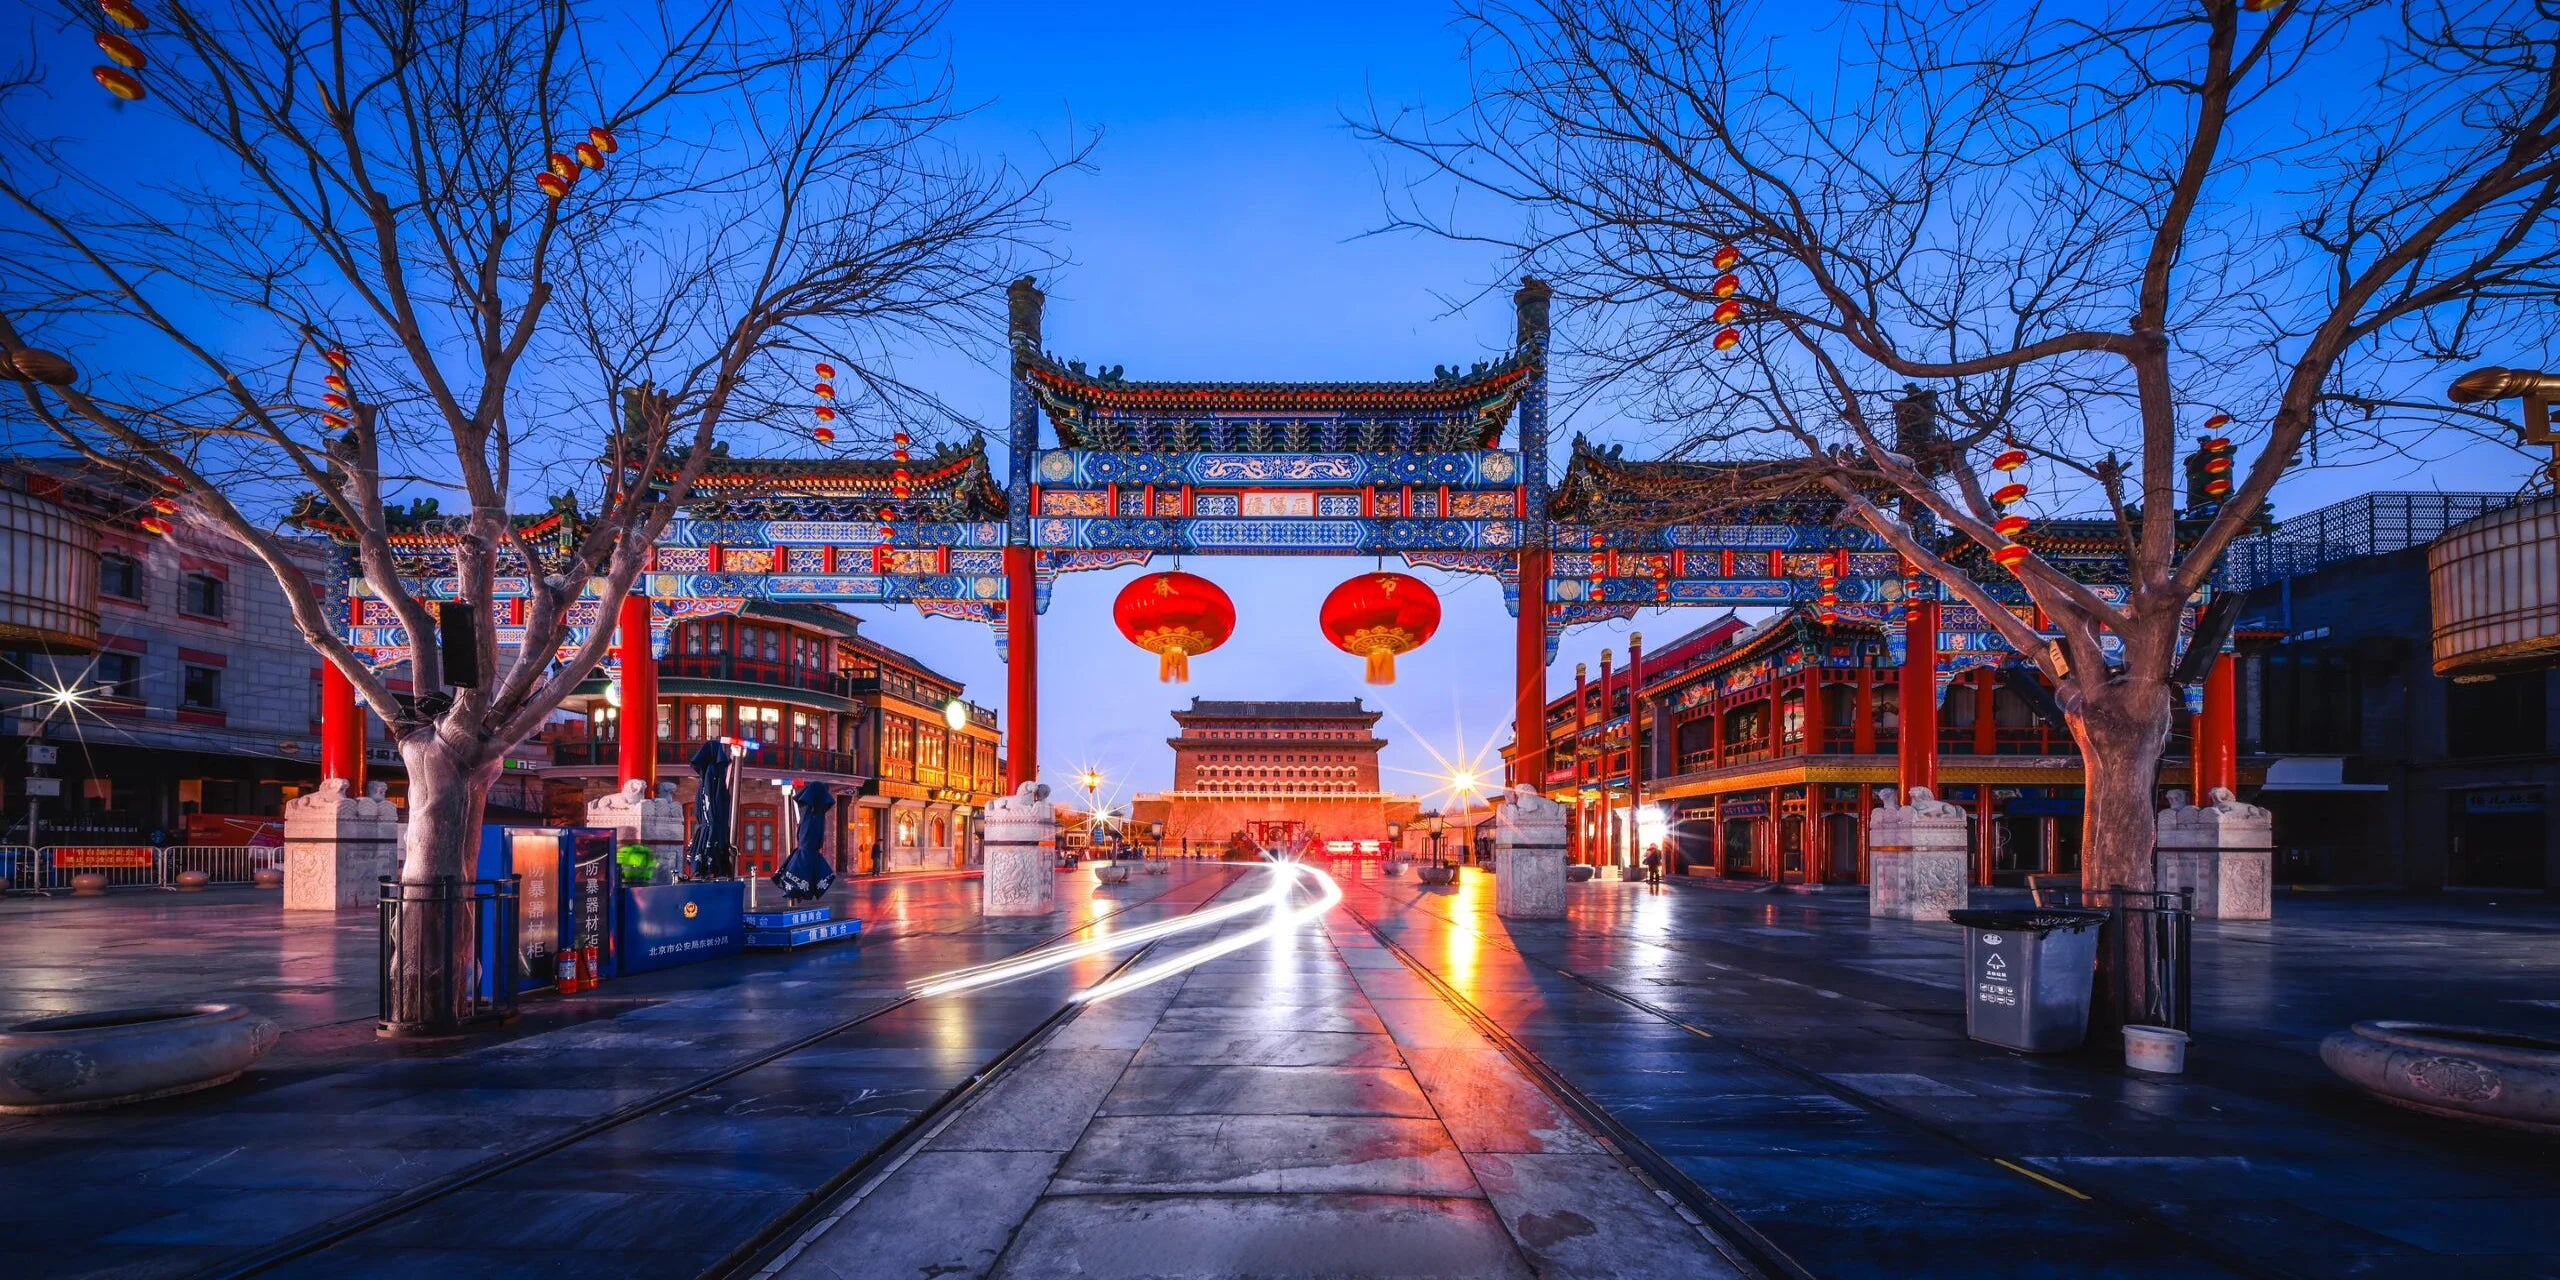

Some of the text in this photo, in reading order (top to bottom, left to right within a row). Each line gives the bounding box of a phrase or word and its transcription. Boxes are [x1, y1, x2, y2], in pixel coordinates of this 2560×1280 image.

[1152, 576, 1179, 598] 春
[1376, 576, 1399, 600] 节
[527, 864, 546, 959] 防暴器材柜
[792, 911, 822, 924] 值勤岗台
[809, 924, 847, 943] 值勤岗台
[648, 935, 729, 957] 北京市公安局东城分局
